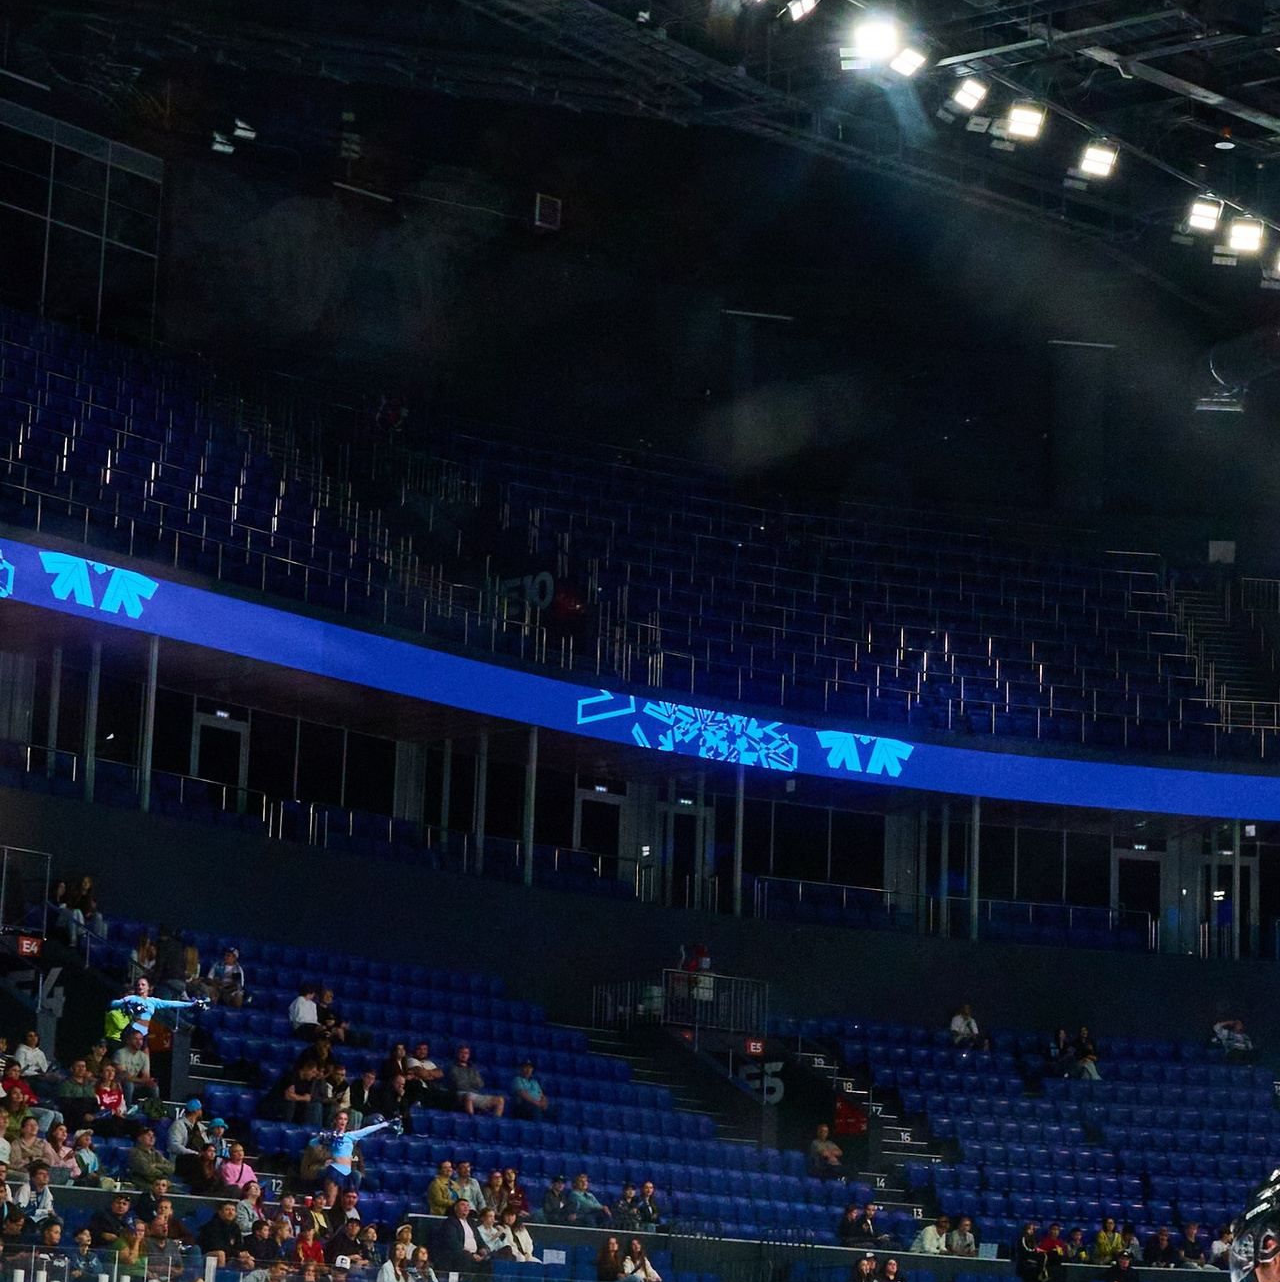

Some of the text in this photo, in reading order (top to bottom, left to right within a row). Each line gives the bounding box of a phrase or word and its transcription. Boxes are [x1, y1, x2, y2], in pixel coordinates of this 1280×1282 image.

[22, 939, 39, 954] E4
[750, 1042, 763, 1053] E5
[271, 1179, 283, 1191] 12
